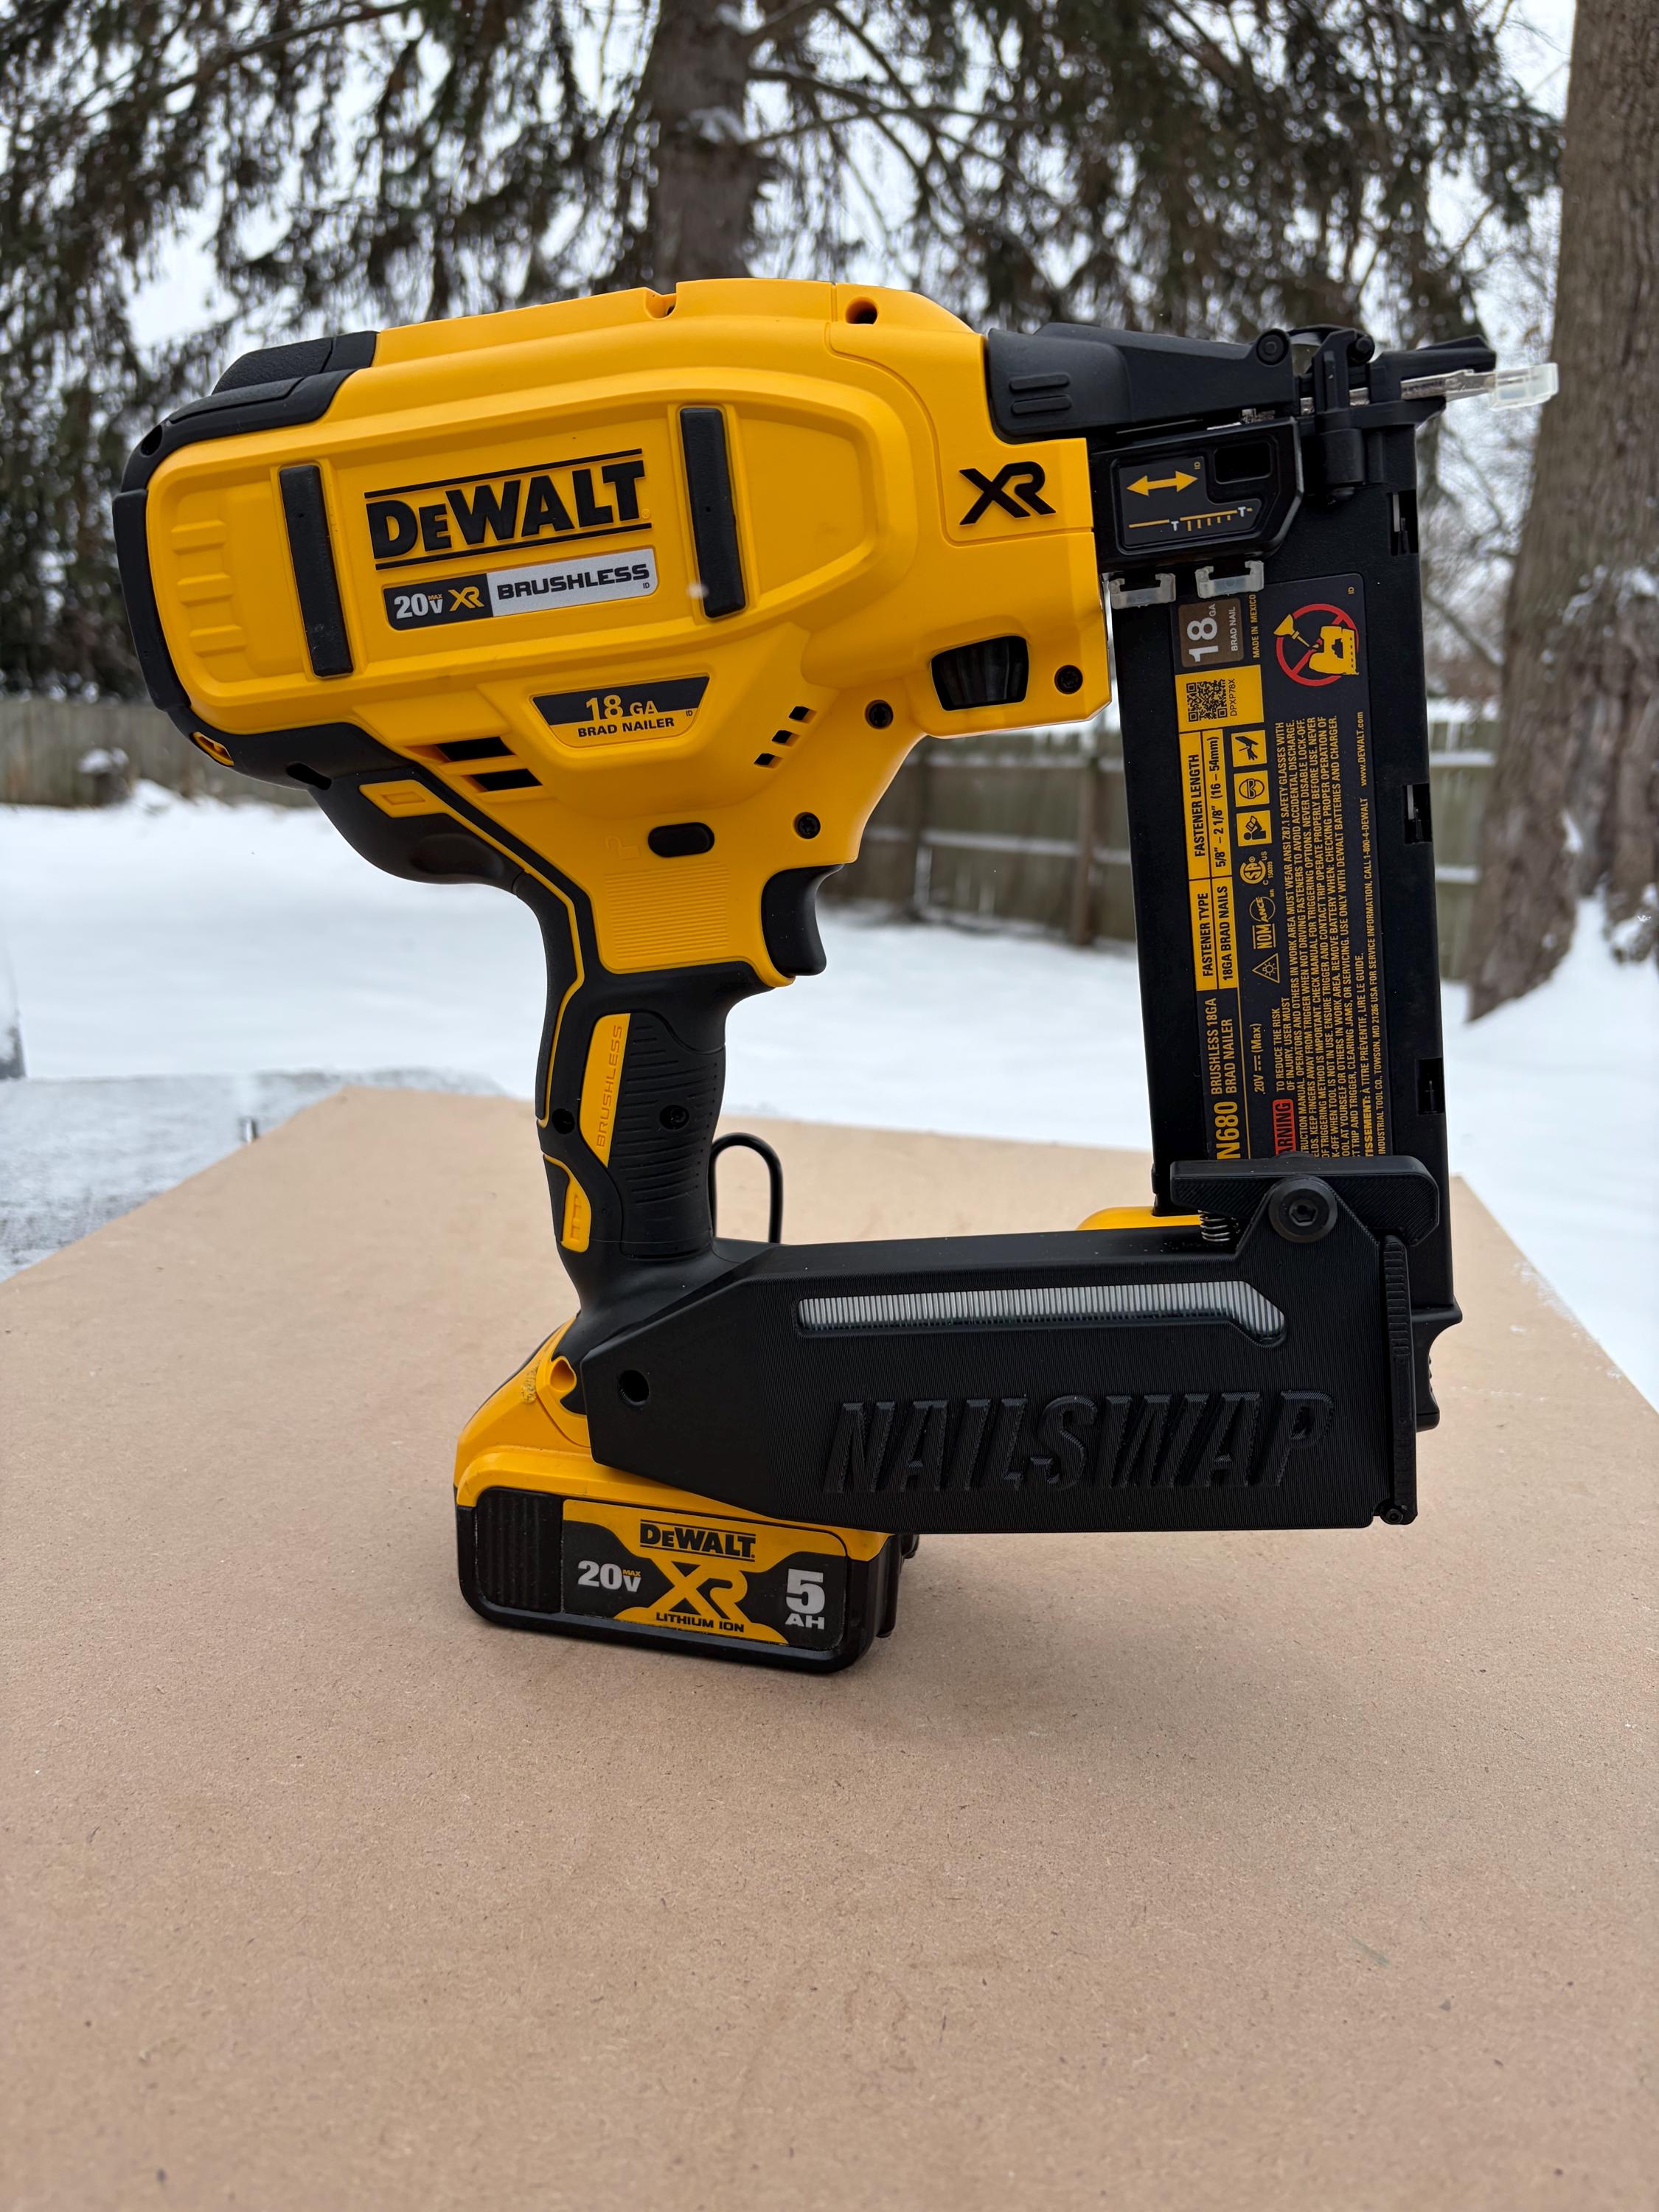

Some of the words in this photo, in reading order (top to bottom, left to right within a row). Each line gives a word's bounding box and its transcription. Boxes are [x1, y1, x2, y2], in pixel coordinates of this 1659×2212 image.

[959, 461, 1056, 525] XR
[366, 460, 646, 559] DEWALT
[428, 593, 443, 601] MAX
[448, 586, 484, 612] XR
[497, 563, 650, 600] BRUSHLESS
[1209, 603, 1216, 616] GA
[1187, 617, 1218, 661] 18
[1251, 626, 1258, 634] IN
[586, 694, 623, 723] 18
[629, 700, 659, 716] GA
[1228, 678, 1237, 716] DPXP78X
[578, 723, 618, 738] BRAD
[622, 717, 675, 732] NAILER
[1276, 722, 1284, 745] WITH
[1296, 718, 1307, 759] LOCK-OFF.
[1307, 717, 1316, 745] NEVER
[1329, 715, 1338, 759] CHARGER.
[1207, 737, 1219, 771] 54mm)
[1286, 720, 1297, 770] DISCHARGE.
[1309, 746, 1318, 765] USE.
[1318, 730, 1329, 779] OPERATION
[1357, 712, 1366, 786] www.DEWALT.com
[1189, 754, 1201, 798] LENGTH
[1277, 747, 1287, 785] GLASSES
[1299, 762, 1309, 797] DISABLE
[1331, 762, 1340, 781] AND
[1211, 783, 1222, 799] (16
[1289, 772, 1300, 823] ACCIDENTAL
[1310, 768, 1319, 799] BEFORE
[1321, 782, 1331, 816] PROPER
[1279, 787, 1289, 817] SAFETY
[1301, 799, 1310, 827] NEVER
[1332, 783, 1343, 830] BATTERIES
[1192, 800, 1205, 856] FASTENER
[1281, 820, 1290, 840] Z87.1
[1312, 801, 1322, 842] PROPERLY
[1360, 798, 1370, 858] 1-800-4-DEWALT
[1283, 841, 1291, 861] ANSI
[1293, 826, 1301, 851] AVOID
[1304, 829, 1312, 868] OPTIONS.
[1324, 818, 1334, 862] CHECKING
[1335, 832, 1344, 867] DEWALT
[1284, 863, 1293, 888] WEAR
[1315, 844, 1324, 880] OPERATE
[1363, 860, 1371, 879] CALL
[1295, 866, 1305, 912] FASTENERS
[1317, 883, 1325, 901] TRIP
[1326, 864, 1335, 894] WHEN:
[1337, 869, 1346, 892] WITH
[1197, 893, 1208, 920] TYPE
[1217, 886, 1228, 918] NAILS
[1286, 891, 1295, 914] MUST
[1305, 870, 1315, 920] TRIGGERING
[1338, 894, 1347, 916] ONLY
[1365, 880, 1374, 936] INFORMATION,
[1287, 916, 1295, 938] AREA
[1308, 922, 1317, 936] FOR
[1318, 902, 1327, 939] CONTACT
[1328, 896, 1338, 933] BATTERY
[1340, 918, 1348, 935] USE
[1220, 922, 1231, 950] BRAD
[1256, 924, 1272, 948] NOM
[1298, 915, 1307, 947] DRIVING
[1200, 922, 1213, 976] FASTENER
[1288, 940, 1298, 965] WORK
[1299, 950, 1308, 967] NOT
[1310, 939, 1318, 975] MANUAL
[1320, 942, 1329, 959] AND
[1330, 935, 1339, 970] REMOVE
[1340, 937, 1351, 984] SERVICING.
[1368, 938, 1376, 968] SERVICE
[1221, 953, 1232, 980] 18GA
[1301, 969, 1310, 994] WHEN
[1321, 961, 1330, 995] TRIGGER
[1355, 953, 1364, 981] GUIDE.
[1290, 978, 1300, 1008] OTHERS
[1311, 976, 1321, 1003] CHECK
[1332, 973, 1340, 997] AREA.
[1205, 998, 1217, 1026] 18GA
[1272, 1008, 1280, 1027] RISK
[1281, 997, 1290, 1021] MUST
[1302, 995, 1312, 1029] TRIGGER
[1323, 998, 1332, 1029] ENSURE
[1333, 999, 1342, 1025] WORK
[1344, 1000, 1353, 1026] JAMS,
[1357, 995, 1366, 1012] LIRE
[1371, 1004, 1379, 1023] 21286
[1283, 1023, 1292, 1045] USER
[1293, 1011, 1301, 1028] AND
[1313, 1005, 1323, 1053] IMPORTANT.
[1372, 1025, 1379, 1037] MD
[1221, 1019, 1234, 1059] NAILER
[1273, 1029, 1281, 1045] THE
[1304, 1031, 1312, 1054] FROM
[1325, 1030, 1333, 1048] USE.
[1346, 1029, 1355, 1069] CLEARING
[1357, 1014, 1368, 1060] PRÉVENTIF,
[1207, 1029, 1222, 1094] BRUSHLESS
[1274, 1046, 1284, 1078] REDUCE
[1284, 1047, 1293, 1078] INJURY,
[1293, 1030, 1304, 1076] OPERATORS
[1306, 1056, 1314, 1079] AWAY
[1335, 1038, 1345, 1070] OTHERS
[1373, 1039, 1381, 1074] TOWSON,
[1224, 1062, 1237, 1093] BRAD
[1317, 1065, 1326, 1098] METHOD
[1326, 1061, 1335, 1077] NOT
[1360, 1062, 1369, 1085] TITRE
[597, 1025, 622, 1147] BRUSHLESS
[1297, 1078, 1306, 1113] MANUAL.
[1307, 1081, 1316, 1113] FINGERS
[1348, 1071, 1357, 1108] TRIGGER,
[1329, 1110, 1338, 1134] WHEN
[1338, 1086, 1348, 1127] YOURSELF
[1350, 1110, 1358, 1127] AND
[1310, 1116, 1318, 1134] KEEP
[1318, 1101, 1329, 1147] TRIGGERING
[1377, 1111, 1385, 1154] INDUSTRIAL
[823, 1391, 1335, 1494] NAILSWAP
[639, 1522, 756, 1558] DEWALT
[622, 1569, 641, 1577] MAX
[647, 1561, 749, 1620] XR
[786, 1568, 825, 1614] 5
[655, 1612, 714, 1629] LITHIUM
[718, 1621, 744, 1633] ION
[785, 1614, 825, 1630] AH
